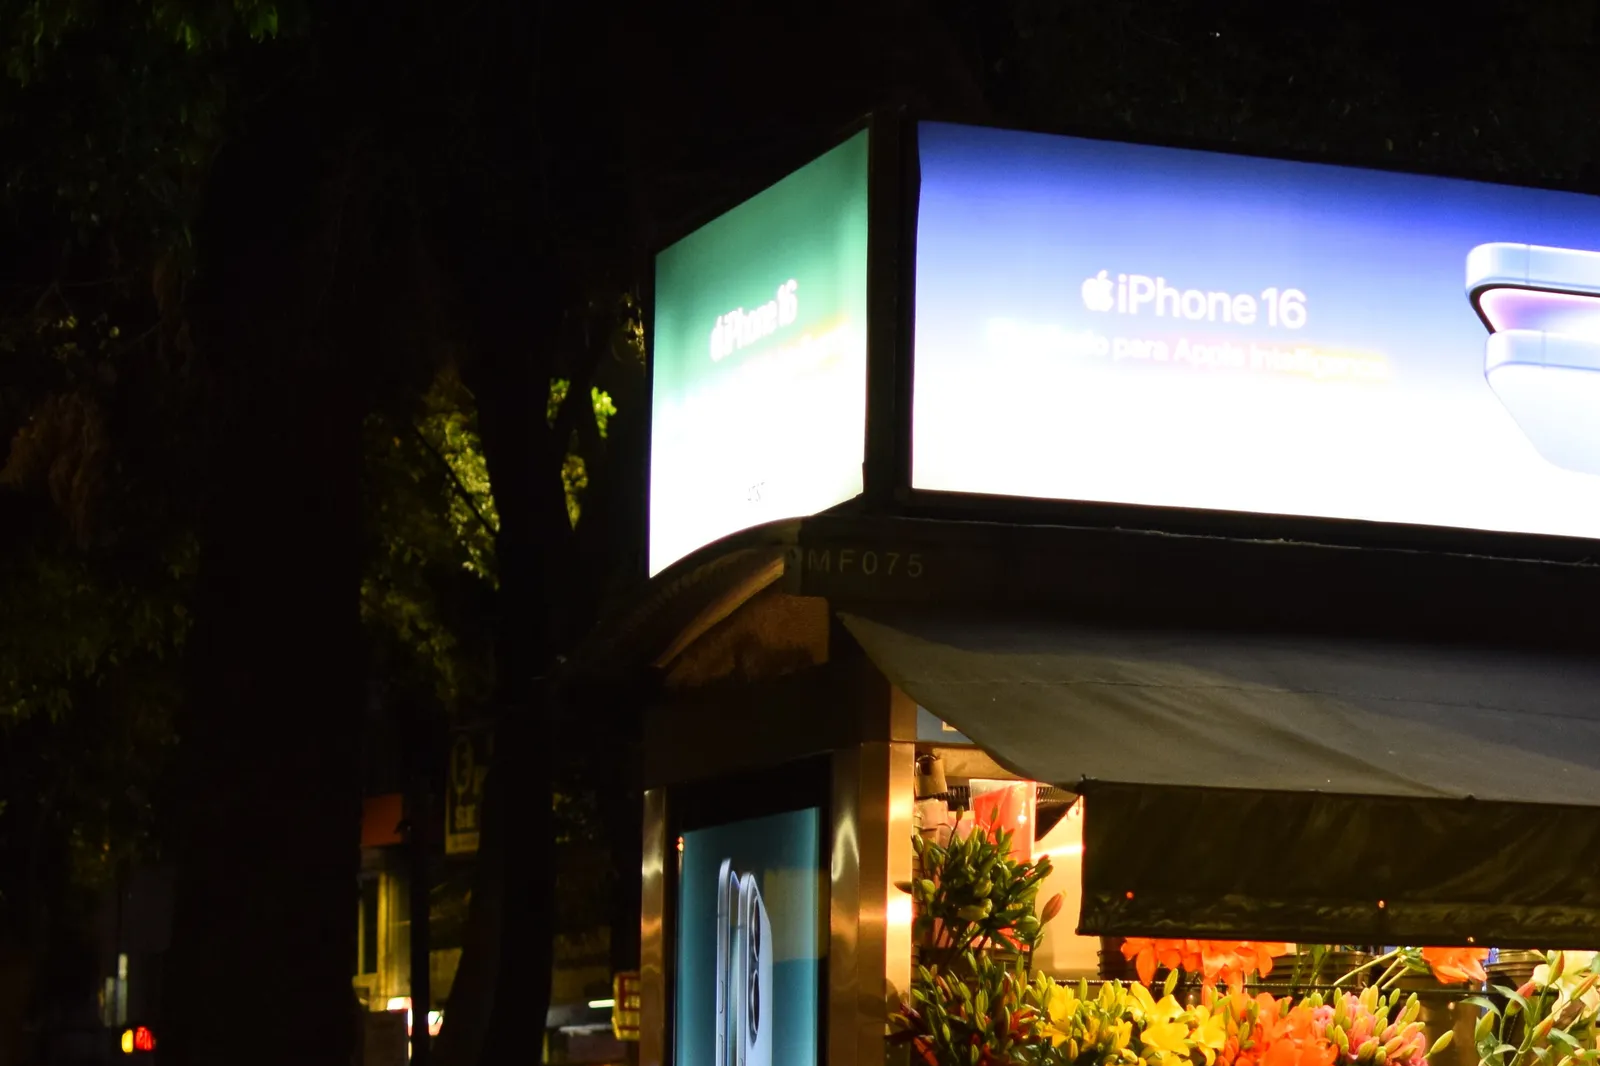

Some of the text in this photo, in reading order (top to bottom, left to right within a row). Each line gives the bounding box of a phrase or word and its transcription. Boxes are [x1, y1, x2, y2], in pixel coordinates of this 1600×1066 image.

[1117, 274, 1307, 330] iPhone 16
[1113, 337, 1168, 362] para
